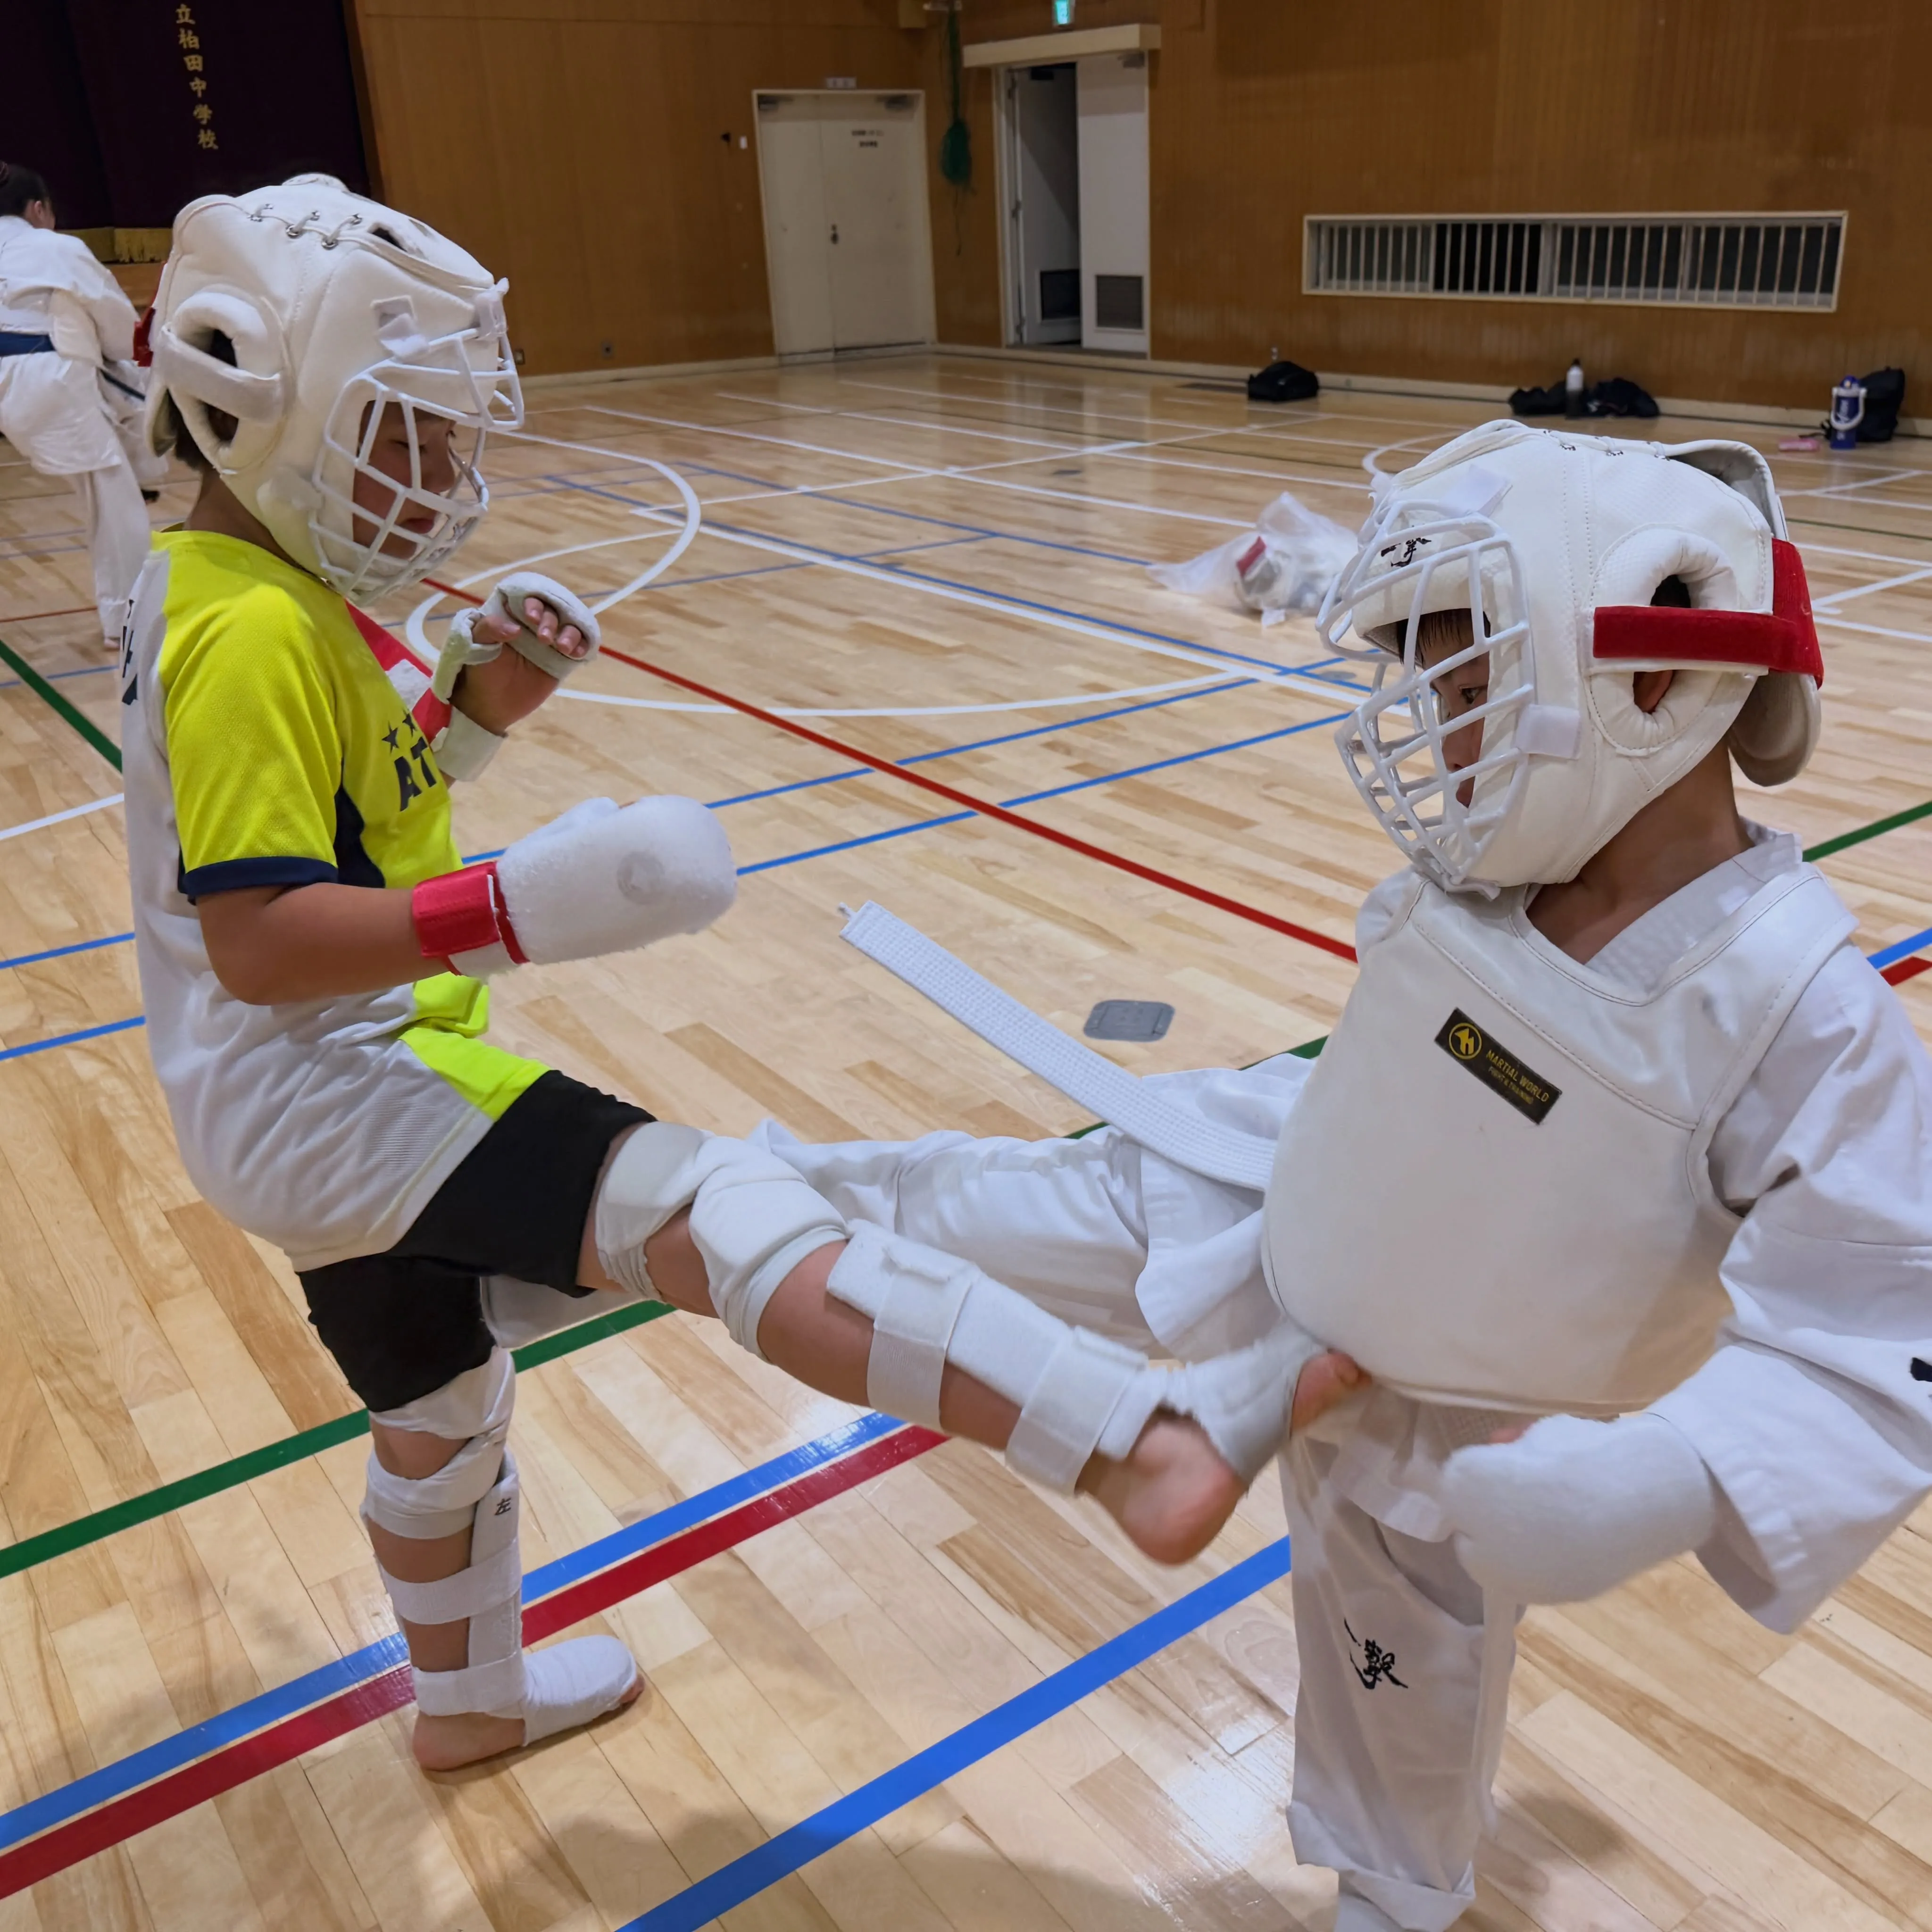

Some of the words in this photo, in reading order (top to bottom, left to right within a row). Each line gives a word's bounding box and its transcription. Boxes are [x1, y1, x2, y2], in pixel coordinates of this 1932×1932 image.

[1486, 1049, 1518, 1082] MARTIAL
[1519, 1075, 1549, 1102] WORLD
[494, 1497, 512, 1516] 左
